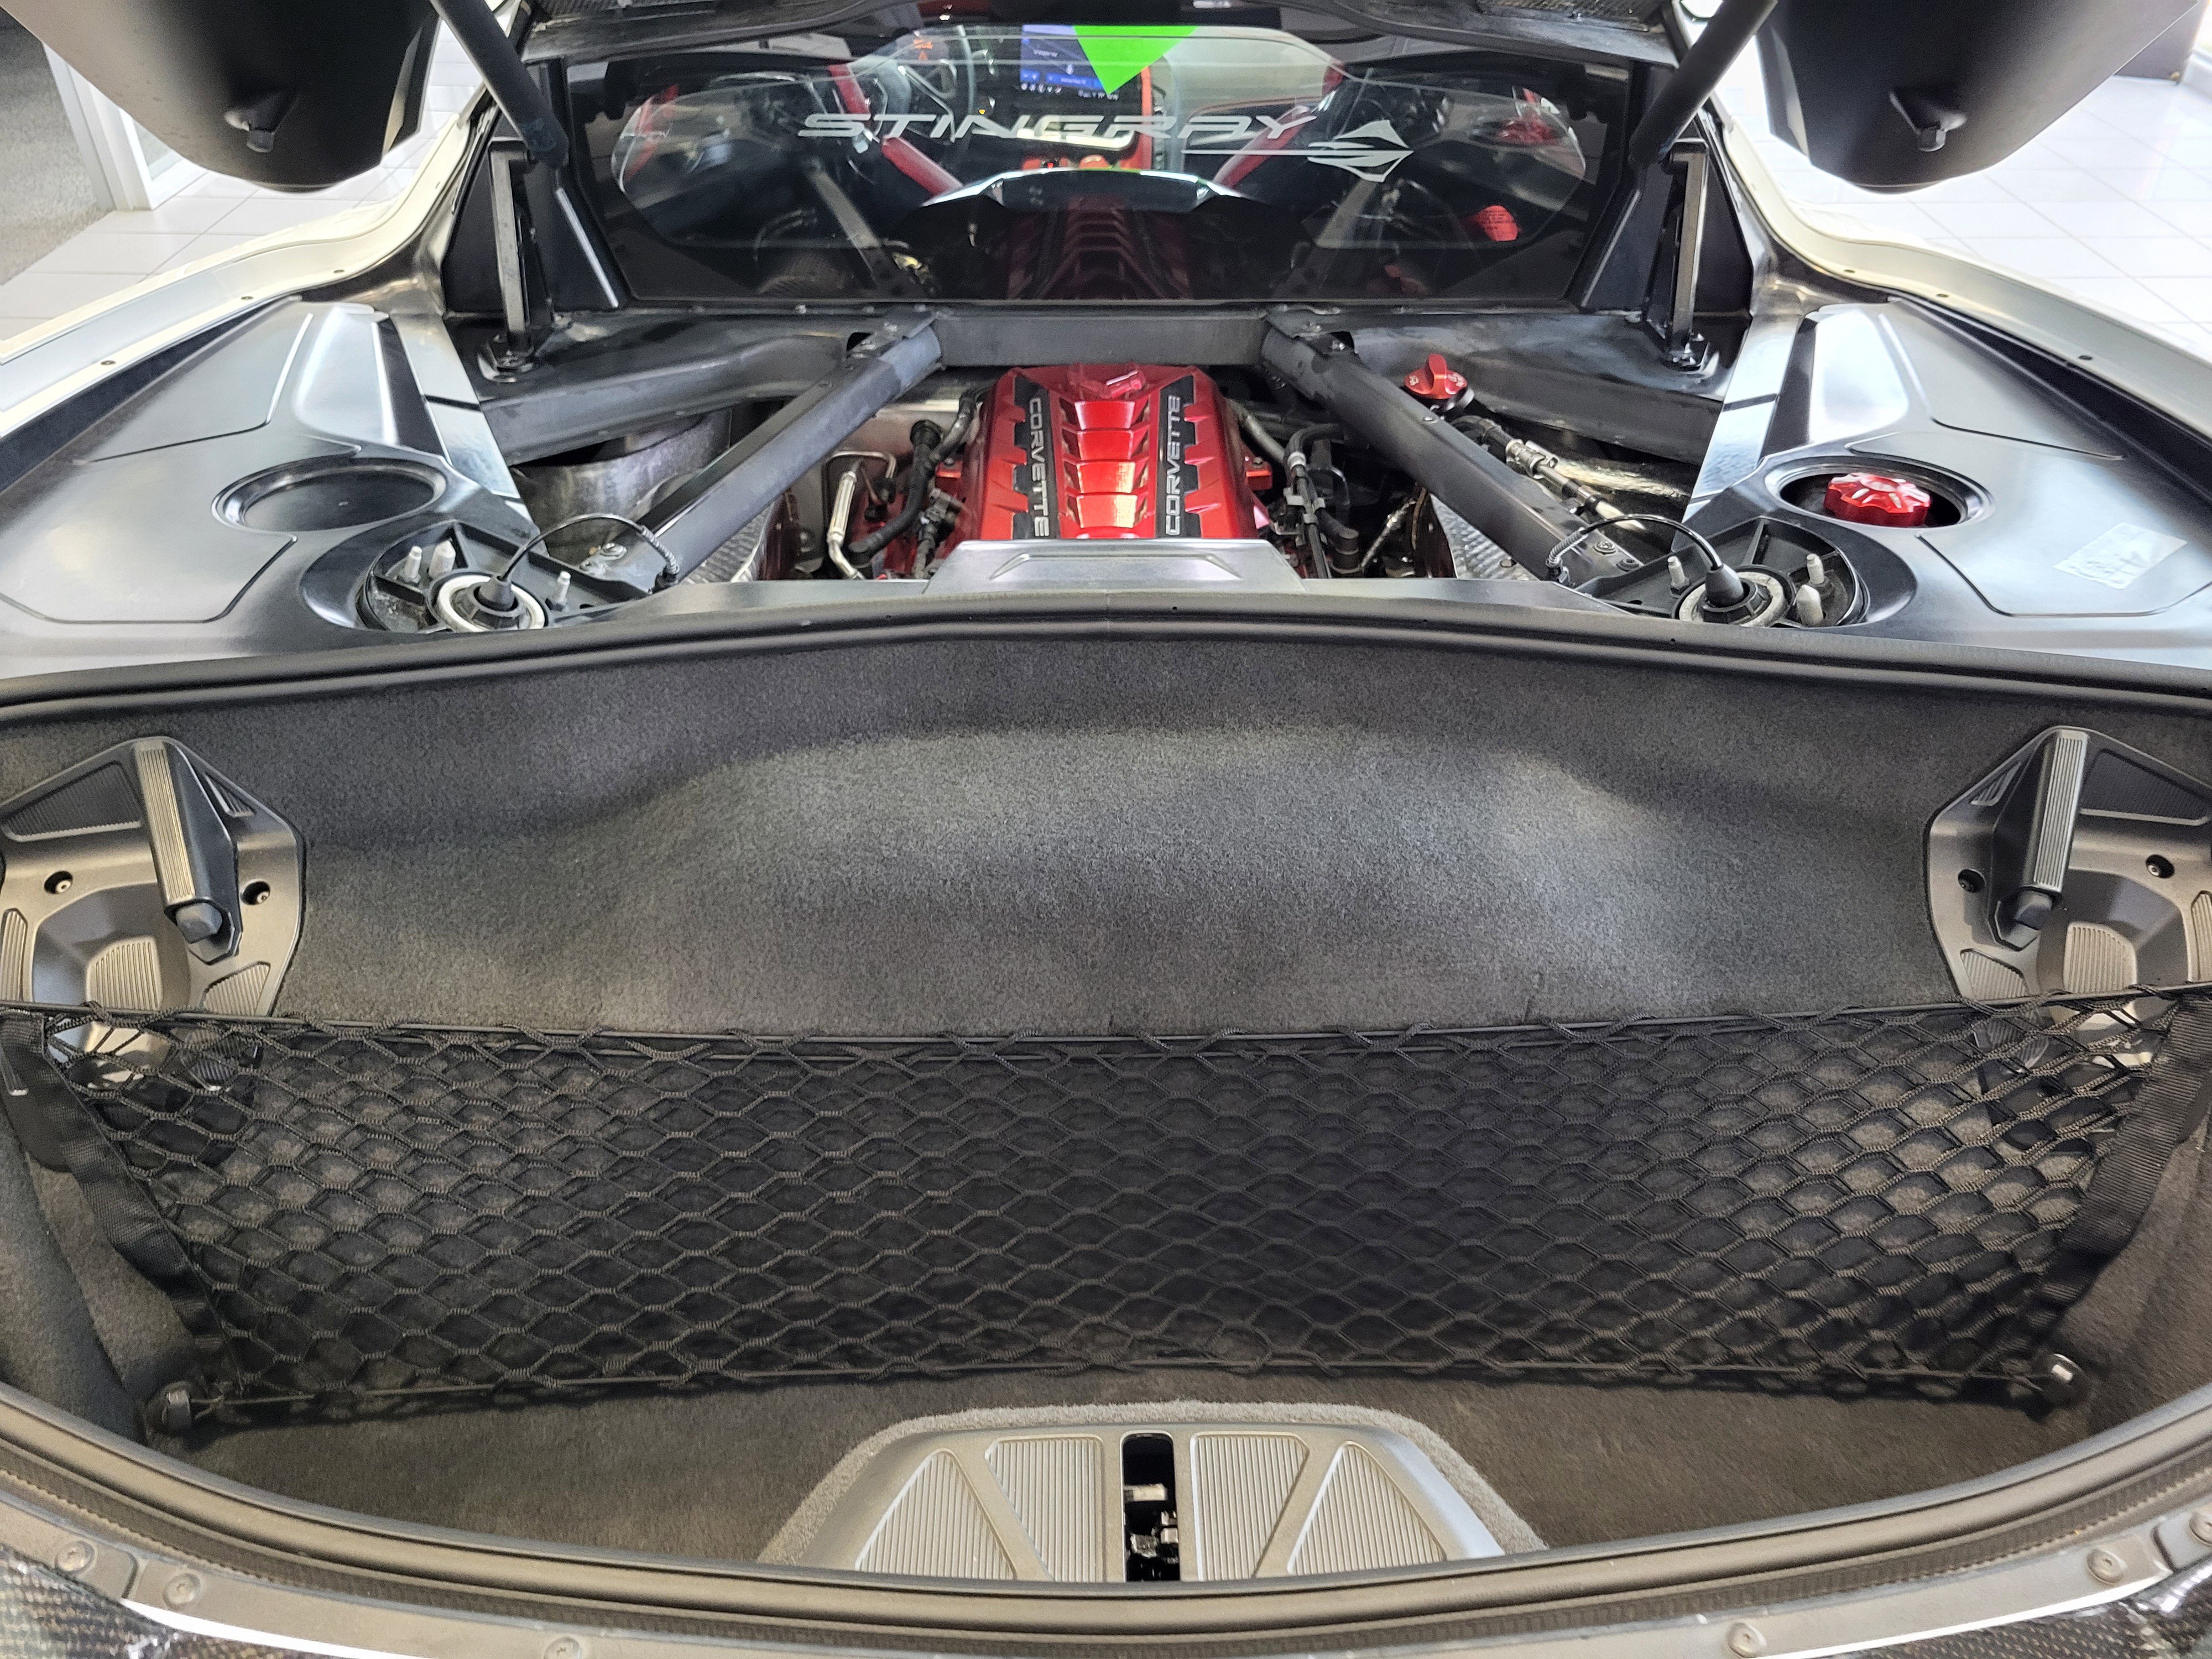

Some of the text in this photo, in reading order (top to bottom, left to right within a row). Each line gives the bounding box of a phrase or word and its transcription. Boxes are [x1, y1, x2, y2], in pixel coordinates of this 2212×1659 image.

[798, 113, 1317, 139] STINGRAY
[1029, 397, 1050, 537] CORVETTE
[1166, 395, 1180, 535] CORVETTE
